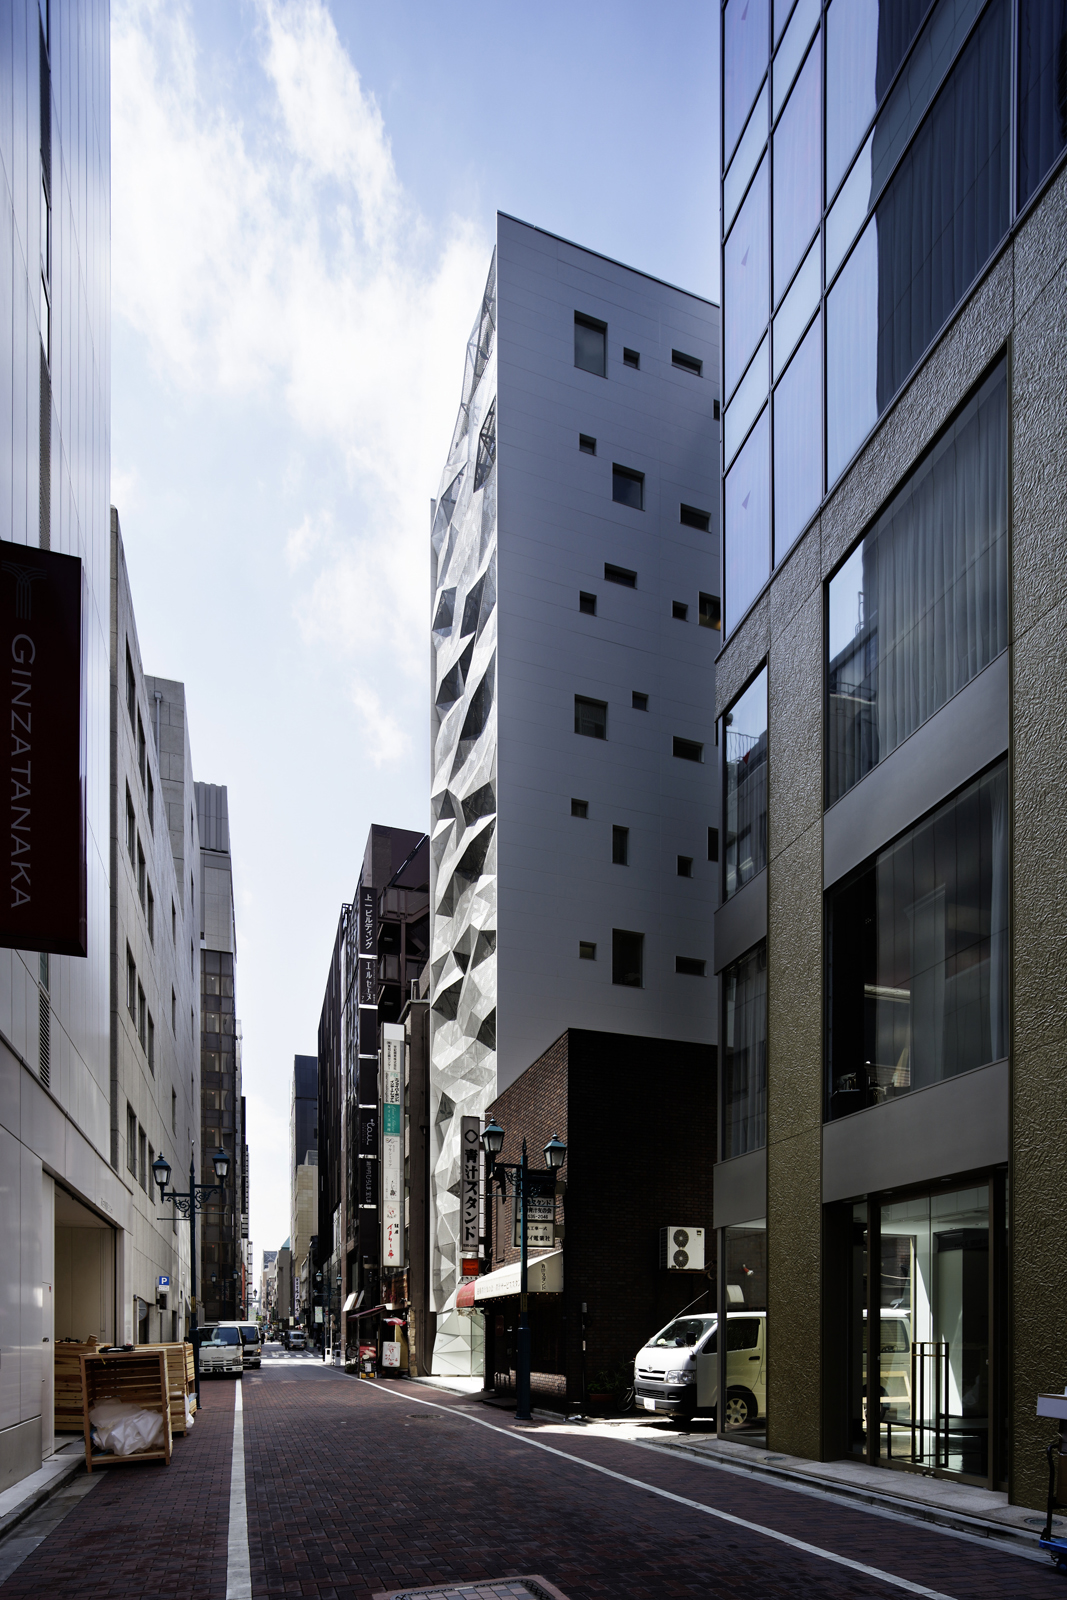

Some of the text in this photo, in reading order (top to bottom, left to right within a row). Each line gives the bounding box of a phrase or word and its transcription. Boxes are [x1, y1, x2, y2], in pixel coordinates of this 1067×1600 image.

[10, 632, 37, 910] GINZATANAKA
[464, 1148, 479, 1242] 青汁スタンド
